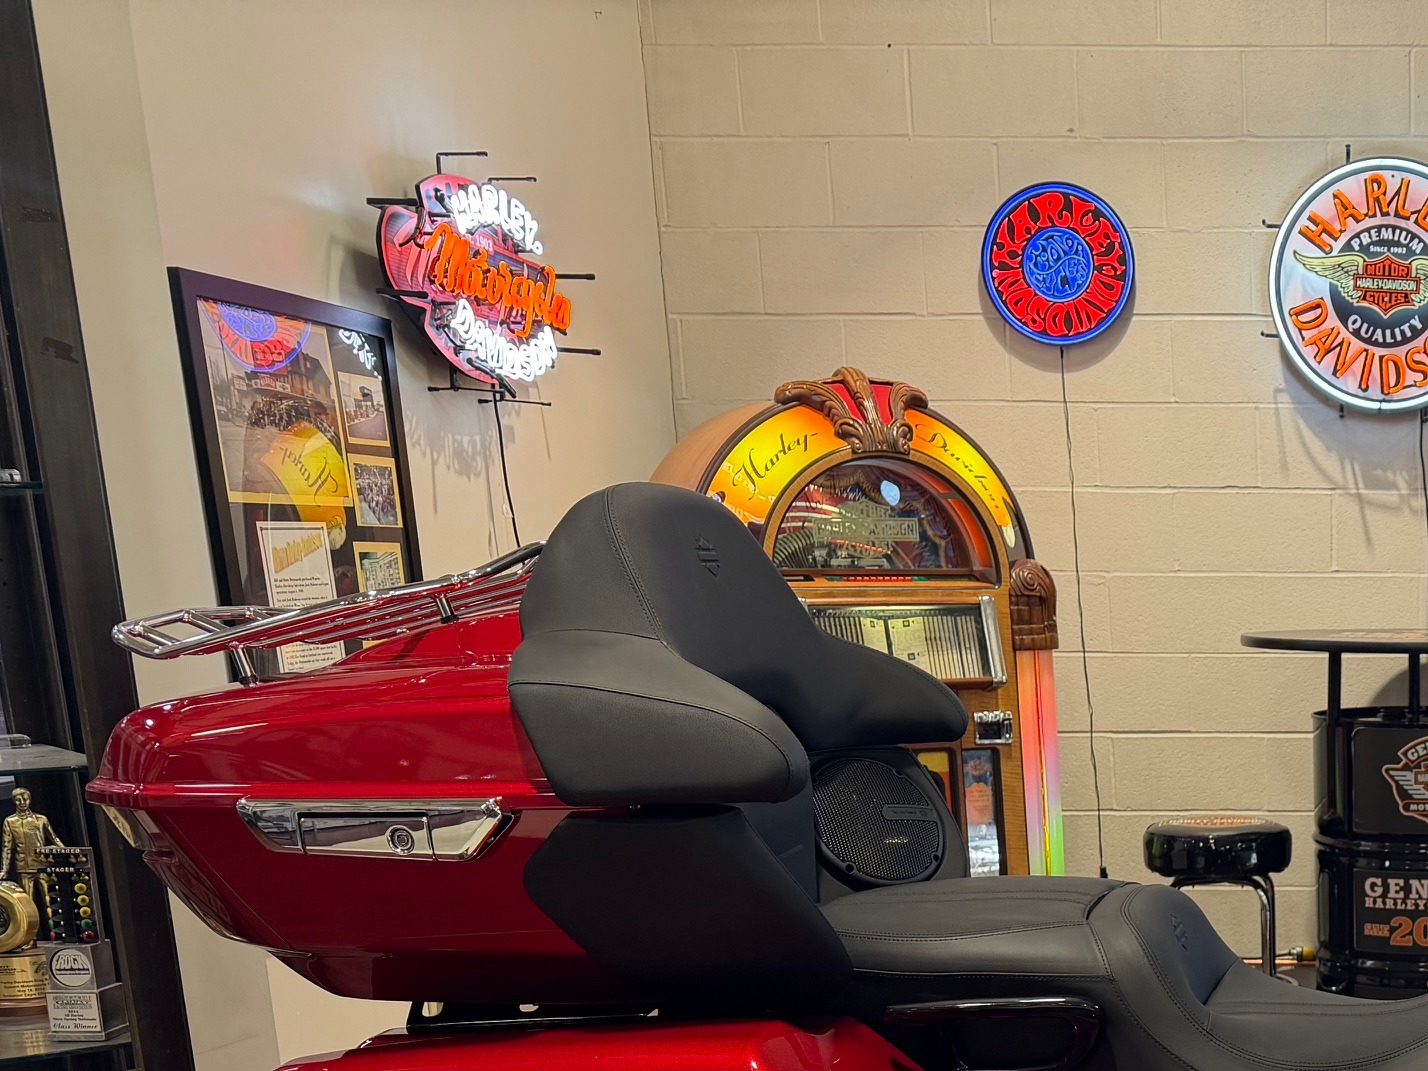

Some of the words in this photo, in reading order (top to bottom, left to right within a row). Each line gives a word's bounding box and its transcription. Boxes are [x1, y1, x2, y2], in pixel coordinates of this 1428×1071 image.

[1350, 227, 1424, 254] PREMIUM
[1366, 260, 1409, 277] MOTOR
[1356, 278, 1417, 291] HARLEY-DAVIDSON
[1365, 291, 1406, 308] CYCLES
[1347, 314, 1425, 343] QUALITY
[1363, 923, 1391, 936] SAE
[56, 954, 89, 970] ROCK
[53, 1022, 71, 1030] Class
[73, 1022, 98, 1030] Winner
